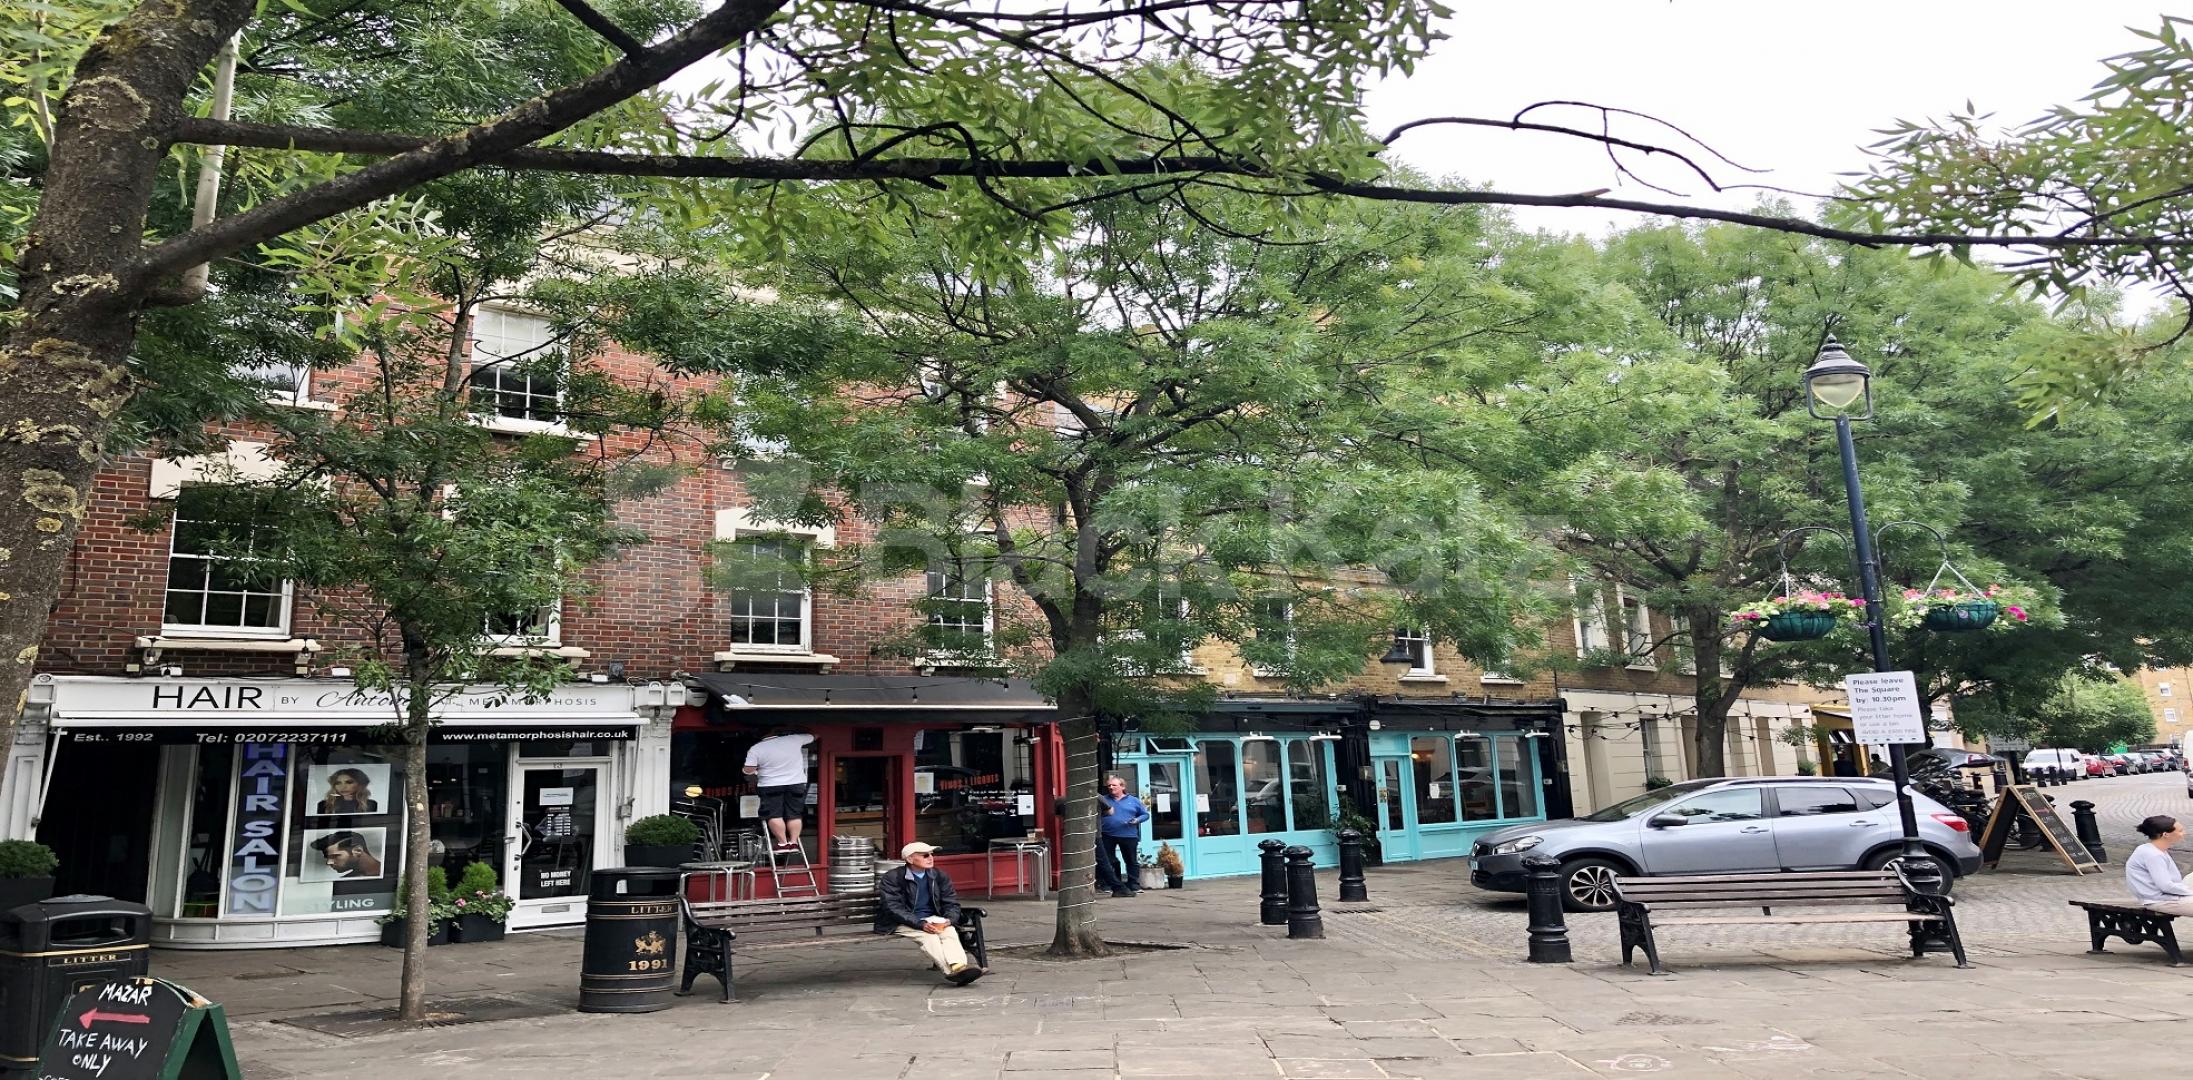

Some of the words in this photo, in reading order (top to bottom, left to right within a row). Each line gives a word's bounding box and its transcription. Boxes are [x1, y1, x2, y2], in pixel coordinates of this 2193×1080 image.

[1880, 677, 1904, 685] leave
[1871, 686, 1900, 694] Square
[152, 686, 263, 709] HAIR
[281, 696, 299, 705] BY
[469, 697, 598, 706] MEAMRHOSIS
[117, 733, 154, 742] 1992
[196, 733, 228, 744] Tel:
[234, 732, 348, 744] 02072237111
[442, 730, 629, 741] www.metamorphosishair.co.uk
[241, 743, 286, 812] HAIR
[231, 820, 280, 912] SALON
[550, 870, 571, 879] MONEY
[540, 880, 555, 888] LEFT
[631, 905, 673, 914] LITTER
[63, 954, 117, 964] LITTER
[629, 959, 668, 971] 1991
[98, 982, 152, 1007] MAZAR
[58, 1028, 99, 1051] TAKE
[99, 1033, 149, 1060] AWAY
[72, 1053, 112, 1079] ONLY
